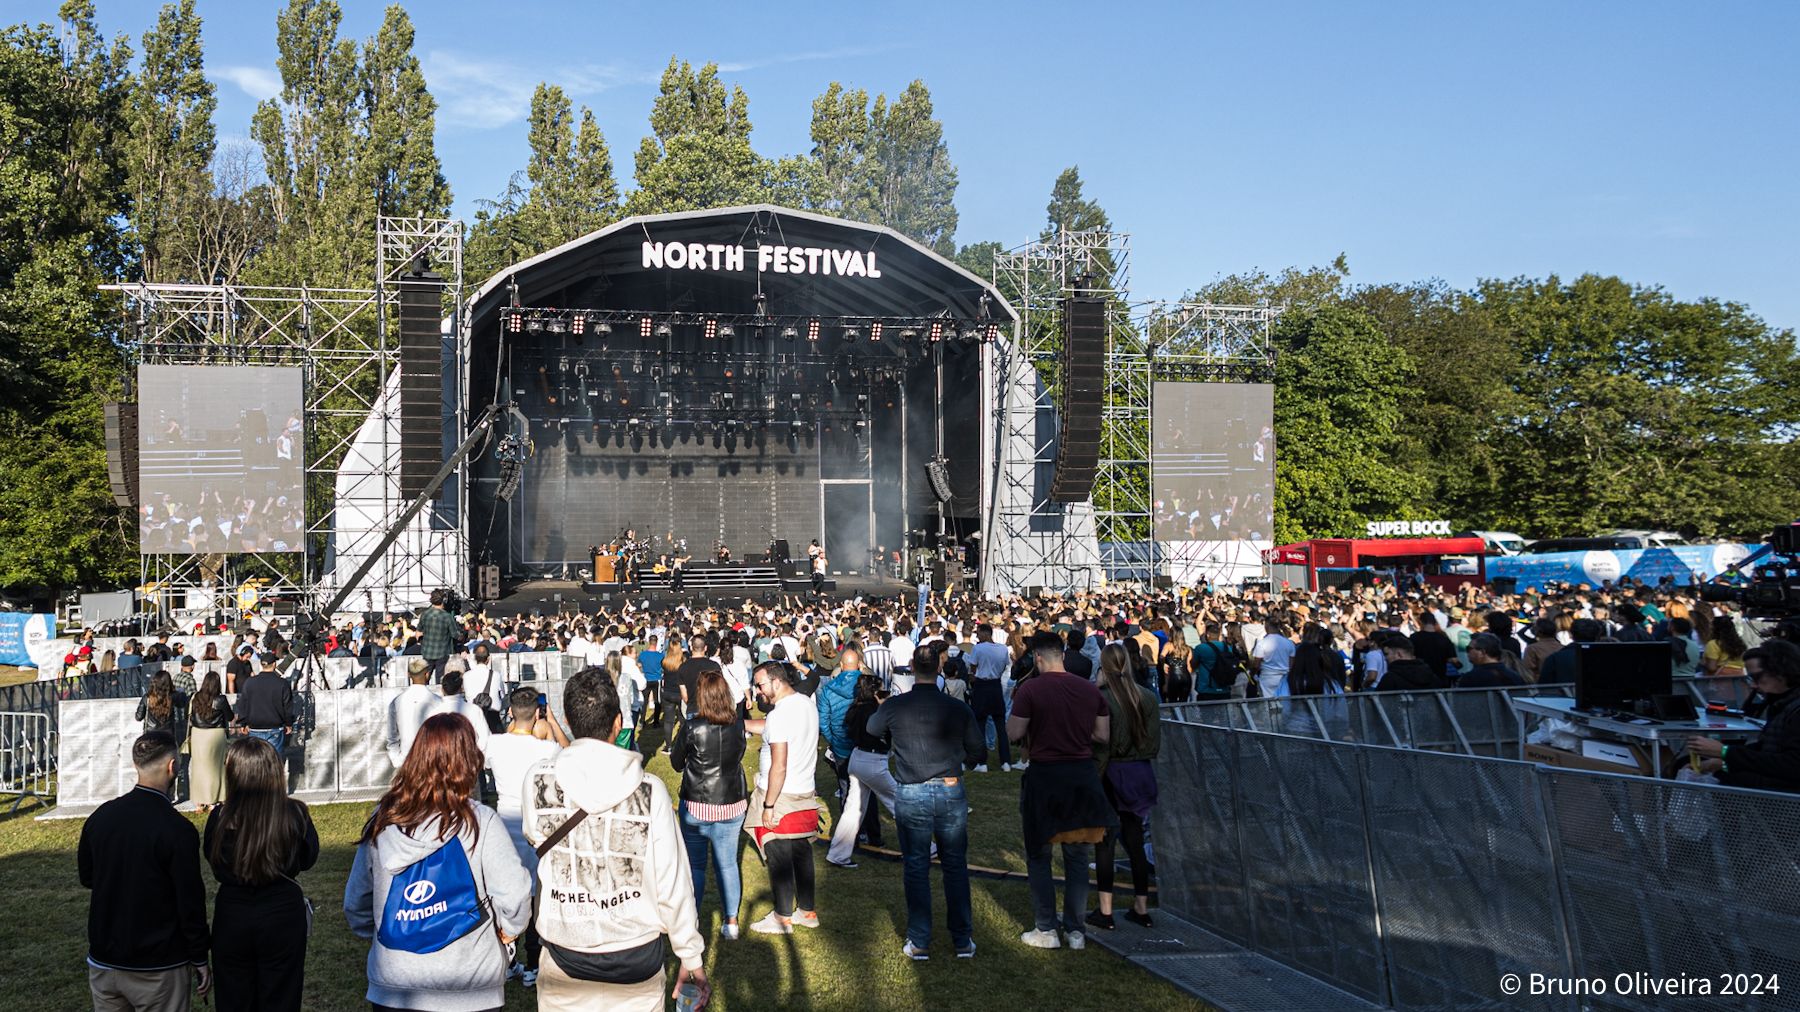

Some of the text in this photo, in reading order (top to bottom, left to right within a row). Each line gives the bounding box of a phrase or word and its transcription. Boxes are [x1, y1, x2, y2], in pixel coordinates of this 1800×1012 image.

[642, 241, 881, 279] NORTH FESTIVAL
[1366, 520, 1451, 536] SUPER BOCK
[550, 888, 641, 910] MCHELNGELO
[395, 900, 448, 921] HYUNDAI
